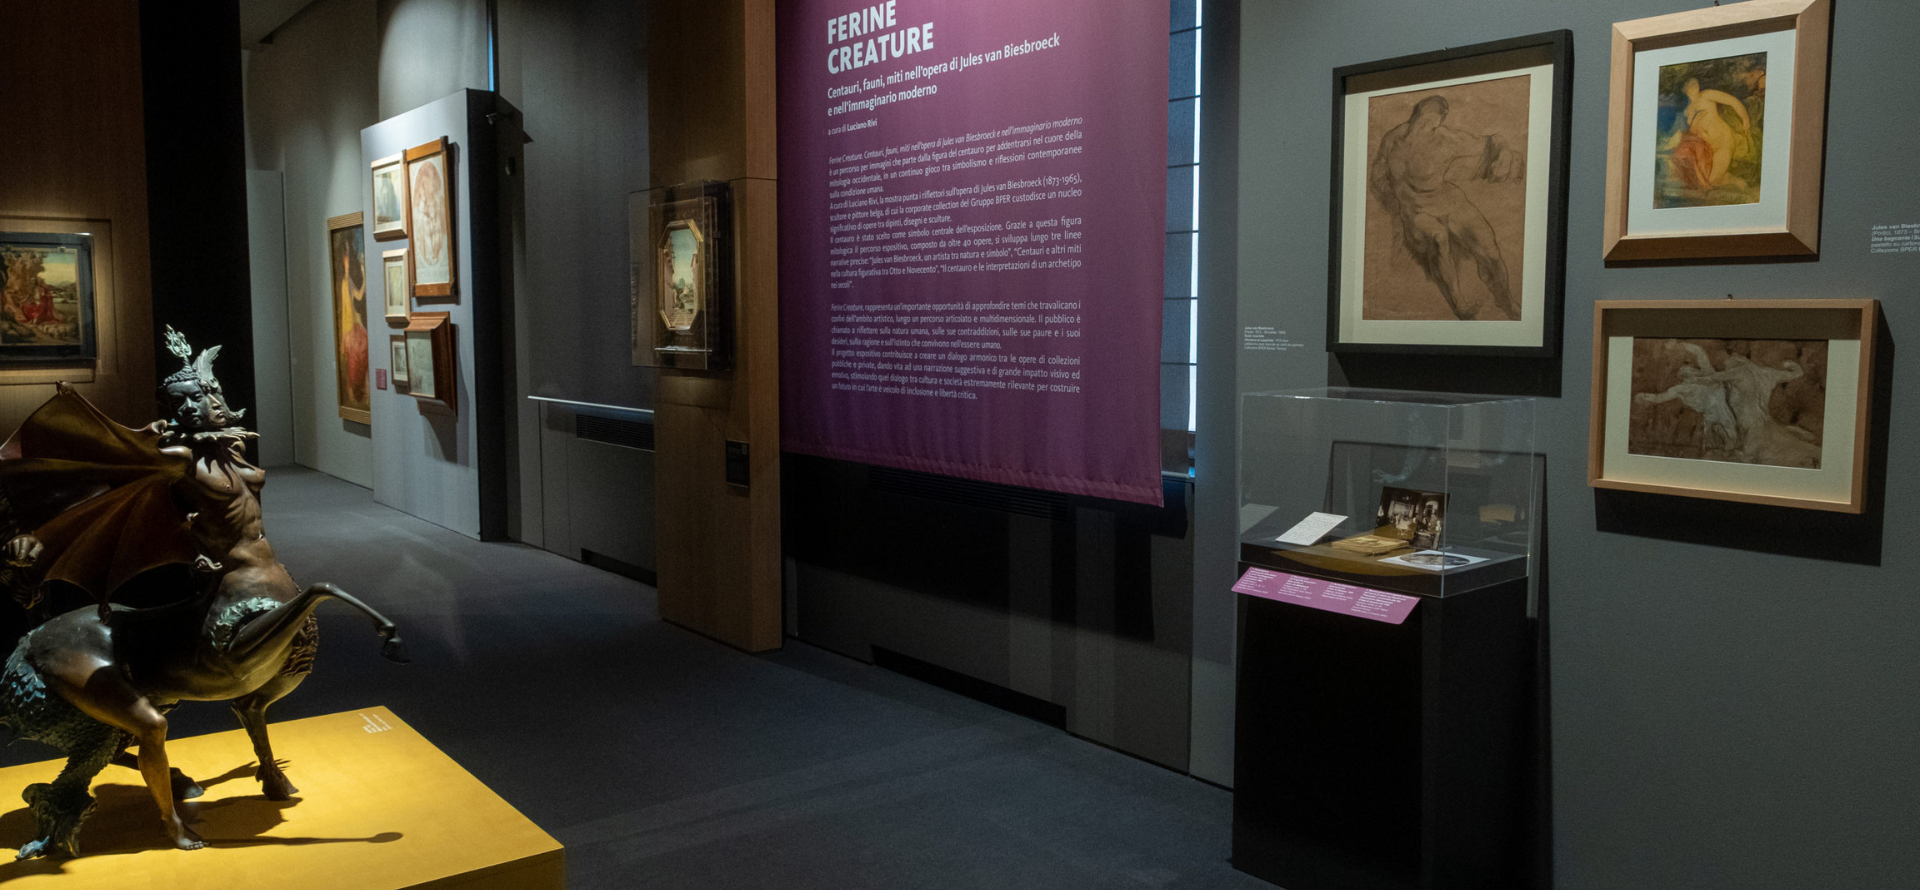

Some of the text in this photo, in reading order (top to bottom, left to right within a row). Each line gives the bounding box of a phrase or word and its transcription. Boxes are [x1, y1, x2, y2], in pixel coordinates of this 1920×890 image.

[828, 0, 896, 44] FERINE
[828, 22, 933, 74] CREATURE
[828, 32, 1060, 98] Centauri, fauni, miti nell'opera di Jules van Biesbroeck
[828, 85, 938, 116] e nell'immaginario moderno
[842, 124, 847, 132] di
[847, 120, 867, 132] Luciano
[868, 118, 878, 128] Rivi
[966, 128, 996, 142] Biesbroeck
[1001, 120, 1052, 136] nell'immaginario
[1052, 116, 1083, 128] moderno
[958, 147, 985, 156] centauro
[986, 145, 996, 155] per
[997, 137, 1032, 150] addentrarsi
[1033, 134, 1044, 145] nel
[1045, 134, 1064, 143] cuore
[1065, 129, 1082, 140] della
[995, 152, 1026, 164] riflessioni
[1027, 146, 1082, 160] contemporanee
[973, 184, 980, 194] di
[981, 183, 996, 195] Jules
[1007, 177, 1042, 190] Biesbroeck
[1043, 172, 1083, 189] (1873-1965),
[970, 198, 994, 208] Gruppo
[996, 194, 1011, 204] BPER
[1012, 191, 1046, 202] custodisce
[1058, 187, 1082, 198] nucleo
[1006, 221, 1027, 230] Grazie
[1035, 218, 1058, 231] questa
[1061, 216, 1082, 228] figura
[1002, 234, 1028, 245] sviluppa
[1031, 232, 1049, 244] lungo
[1051, 232, 1061, 240] tre
[1064, 230, 1082, 239] linee
[1014, 246, 1045, 256] “Centauri
[1051, 244, 1066, 254] altri
[1067, 244, 1082, 253] miti
[978, 262, 985, 271] le
[986, 261, 1030, 273] interpretazioni
[1031, 260, 1038, 269] di
[1048, 258, 1082, 270] archetipo
[972, 301, 1010, 312] approfondire
[1011, 301, 1027, 309] temi
[1027, 300, 1038, 309] che
[1040, 300, 1078, 309] travalicano
[1045, 314, 1075, 326] pubblico
[1002, 327, 1018, 336] sulle
[1033, 330, 1052, 339] paure
[1066, 329, 1081, 337] suoi
[970, 354, 997, 362] armonico
[999, 354, 1008, 362] tra
[1010, 354, 1017, 362] le
[1018, 357, 1037, 366] opere
[1039, 354, 1046, 364] di
[1047, 355, 1080, 365] collezioni
[999, 366, 1021, 378] grande
[1023, 368, 1048, 379] impatto
[1050, 369, 1070, 378] visivo
[1072, 369, 1080, 378] ed
[964, 378, 1006, 388] estremamente
[1008, 380, 1035, 390] rilevante
[1037, 384, 1048, 393] per
[1050, 383, 1080, 393] costruire
